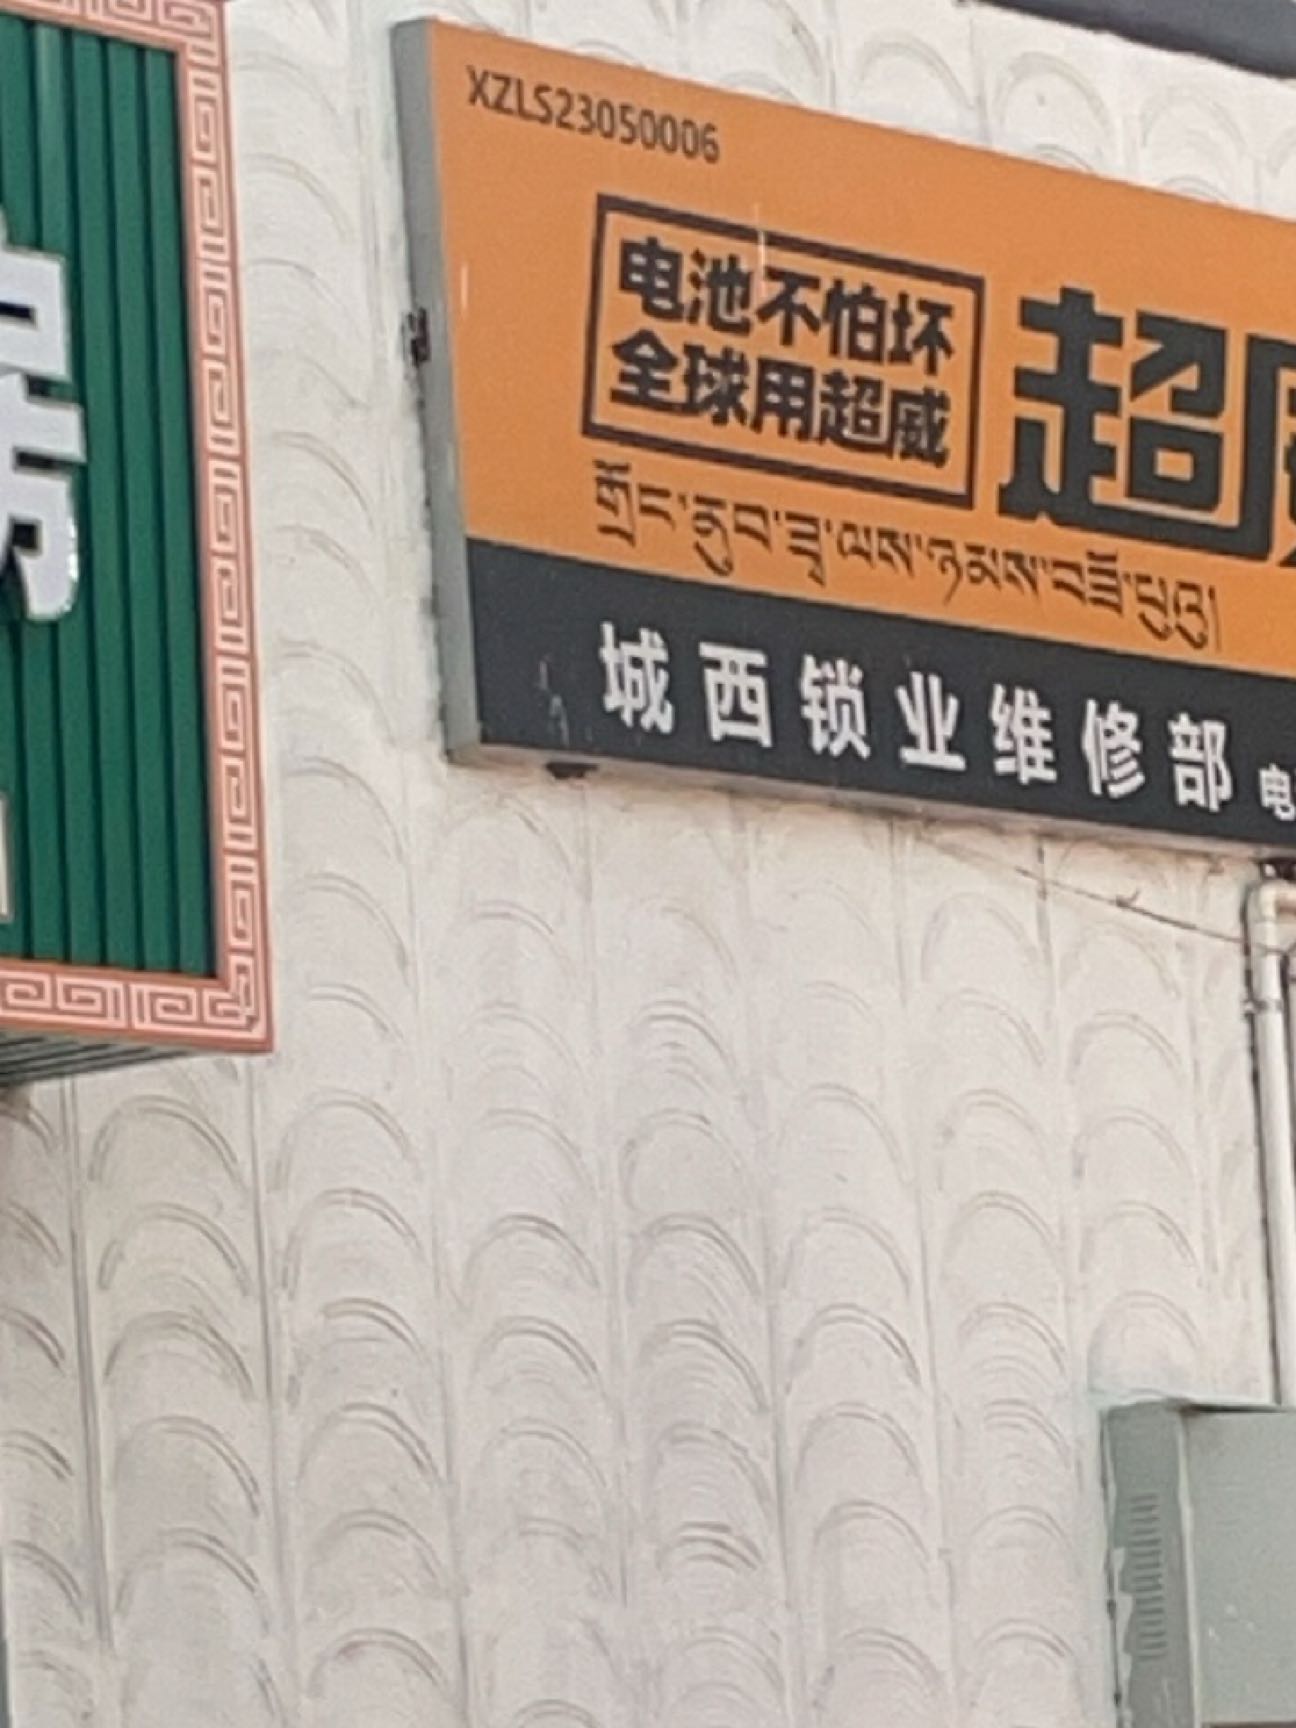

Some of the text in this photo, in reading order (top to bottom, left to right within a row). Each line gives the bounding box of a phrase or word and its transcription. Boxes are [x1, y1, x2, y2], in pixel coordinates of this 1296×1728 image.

[468, 66, 721, 163] XZLS23050006
[618, 236, 955, 377] 电池不怕坏
[610, 329, 951, 469] 全球用超威
[598, 621, 1233, 813] 城西锁业维修部
